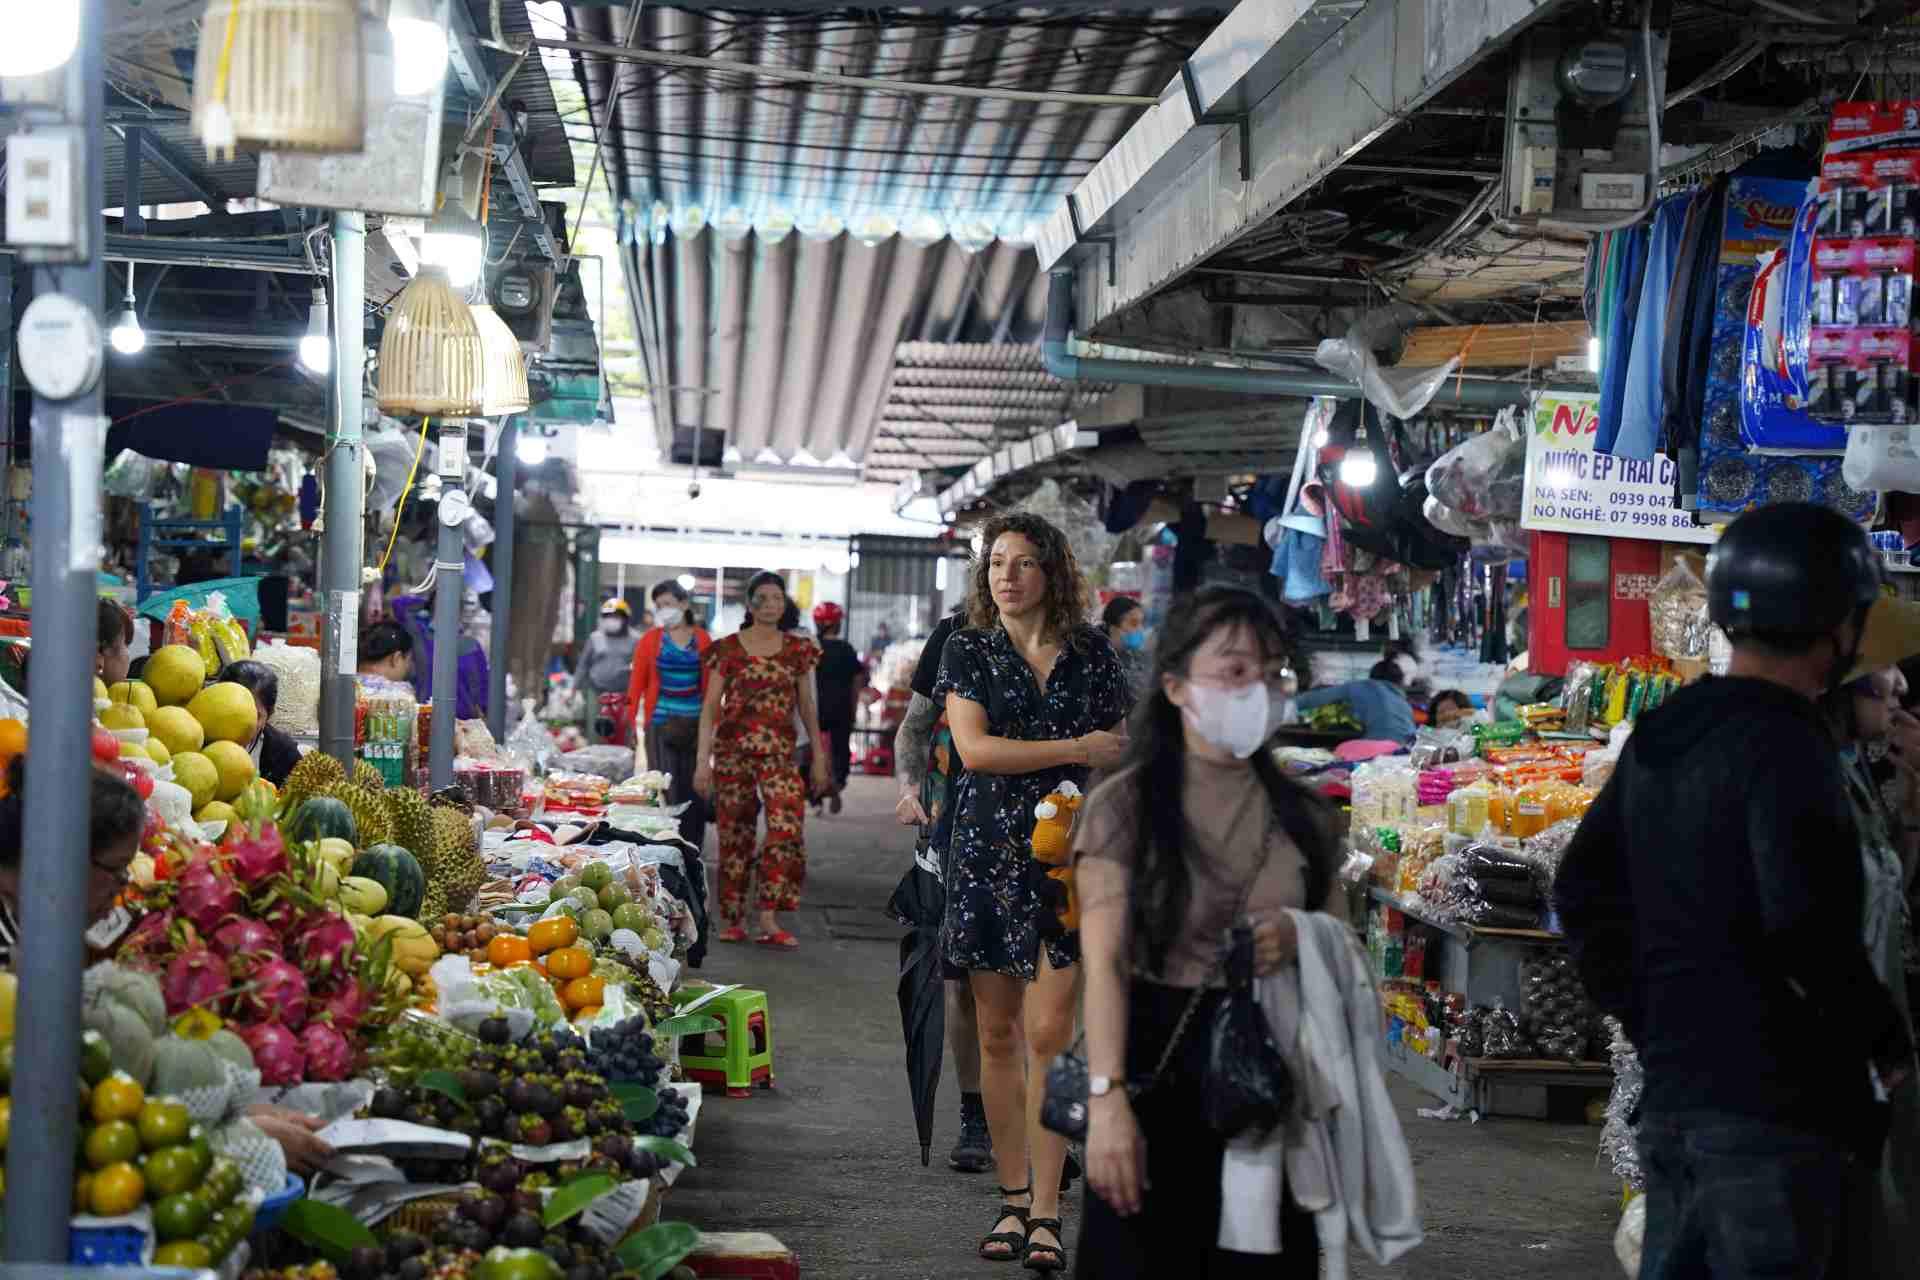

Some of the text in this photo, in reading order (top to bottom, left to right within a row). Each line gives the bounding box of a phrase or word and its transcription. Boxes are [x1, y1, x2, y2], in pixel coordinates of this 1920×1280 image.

[1609, 492, 1644, 506] 0939
[1610, 510, 1628, 523] 07
[1632, 512, 1667, 527] 9998
[1672, 515, 1705, 529] 86
